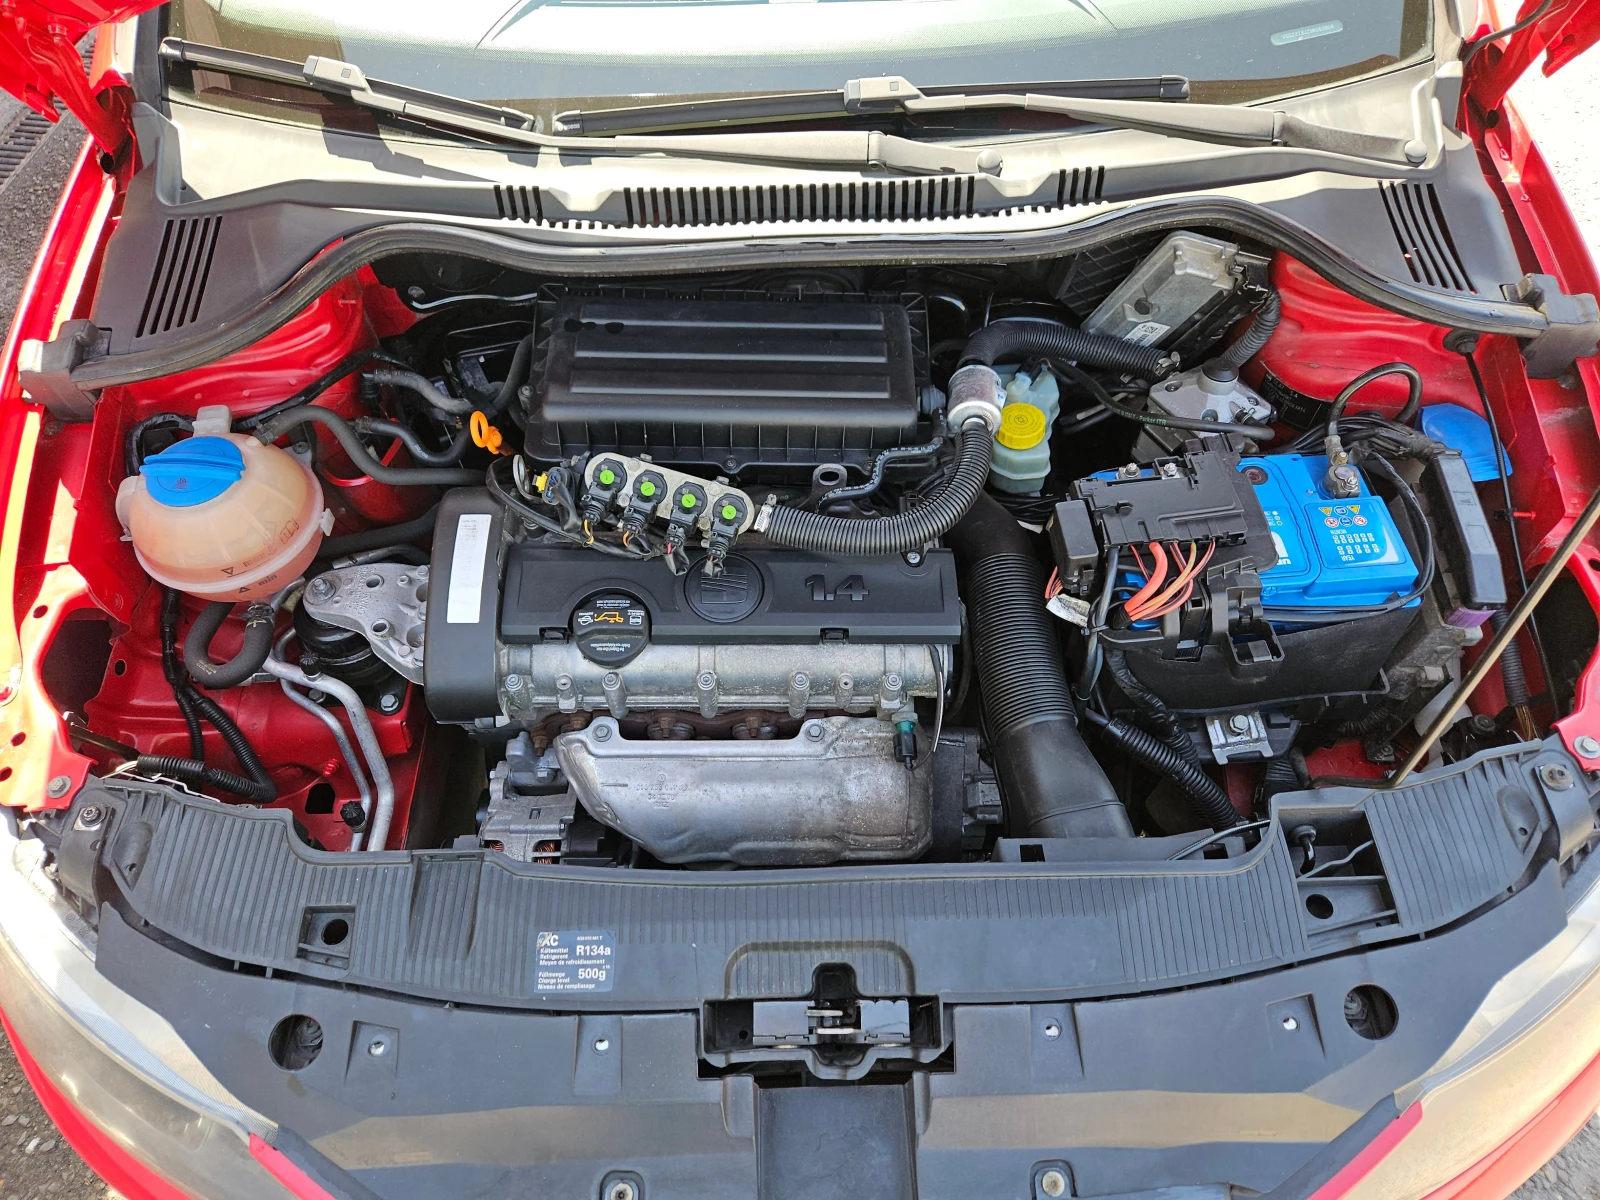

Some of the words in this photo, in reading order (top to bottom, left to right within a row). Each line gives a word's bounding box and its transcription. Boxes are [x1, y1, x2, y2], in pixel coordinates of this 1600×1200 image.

[1139, 415, 1156, 424] Parker
[1156, 418, 1167, 426] ITR
[258, 574, 277, 586] min
[804, 574, 869, 601] 1.4
[576, 945, 611, 956] R134a
[578, 968, 606, 981] 500g
